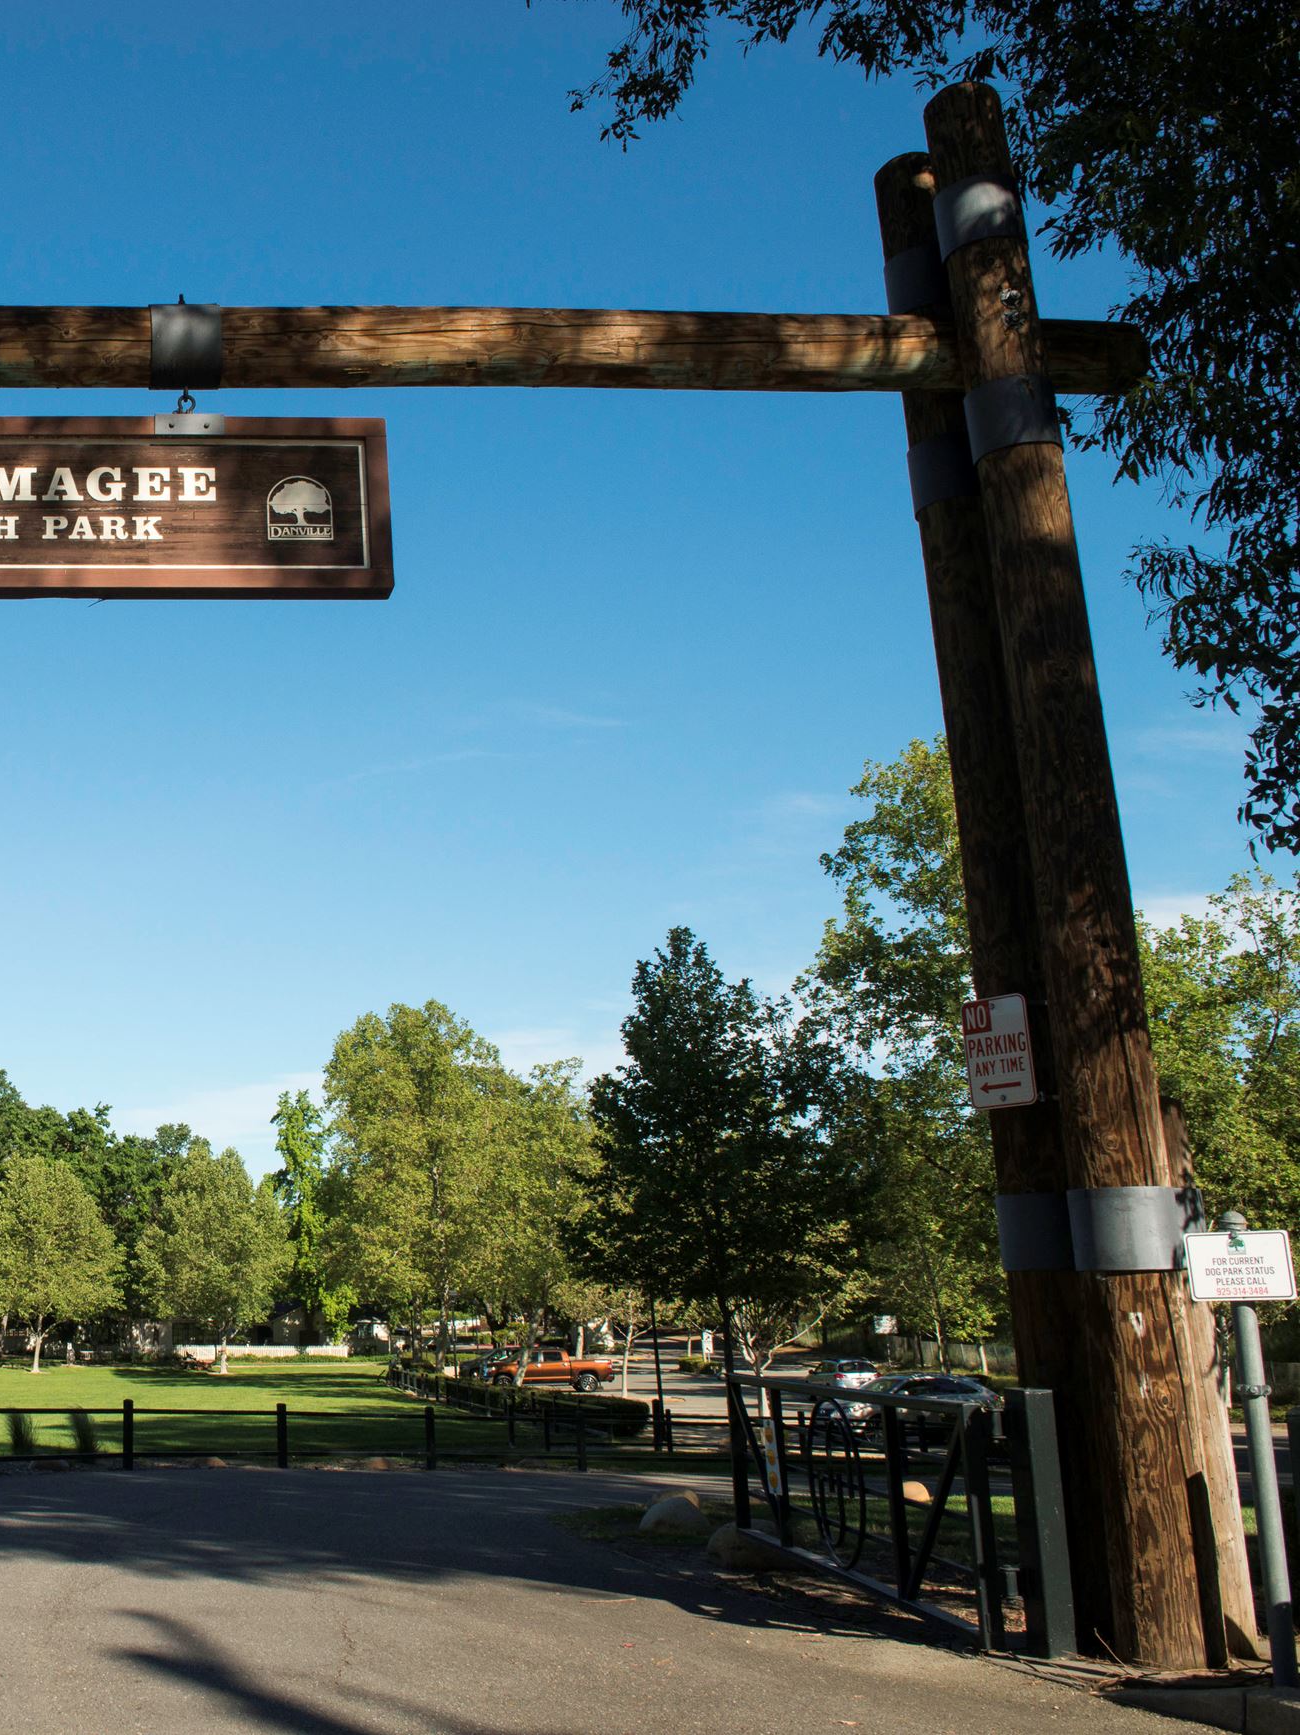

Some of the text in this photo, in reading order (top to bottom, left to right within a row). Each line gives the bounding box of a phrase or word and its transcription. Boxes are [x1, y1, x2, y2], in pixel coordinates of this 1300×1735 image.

[42, 515, 164, 540] PARK
[271, 526, 331, 538] DANVILLE
[965, 1005, 987, 1031] NO
[968, 1032, 1026, 1059] PARKING
[975, 1056, 1025, 1077] ANY TIME
[1212, 1256, 1264, 1265] FOR CURRENT
[1205, 1266, 1275, 1276] DOG PARK STATUS
[1216, 1276, 1267, 1286] PLEASE CALL
